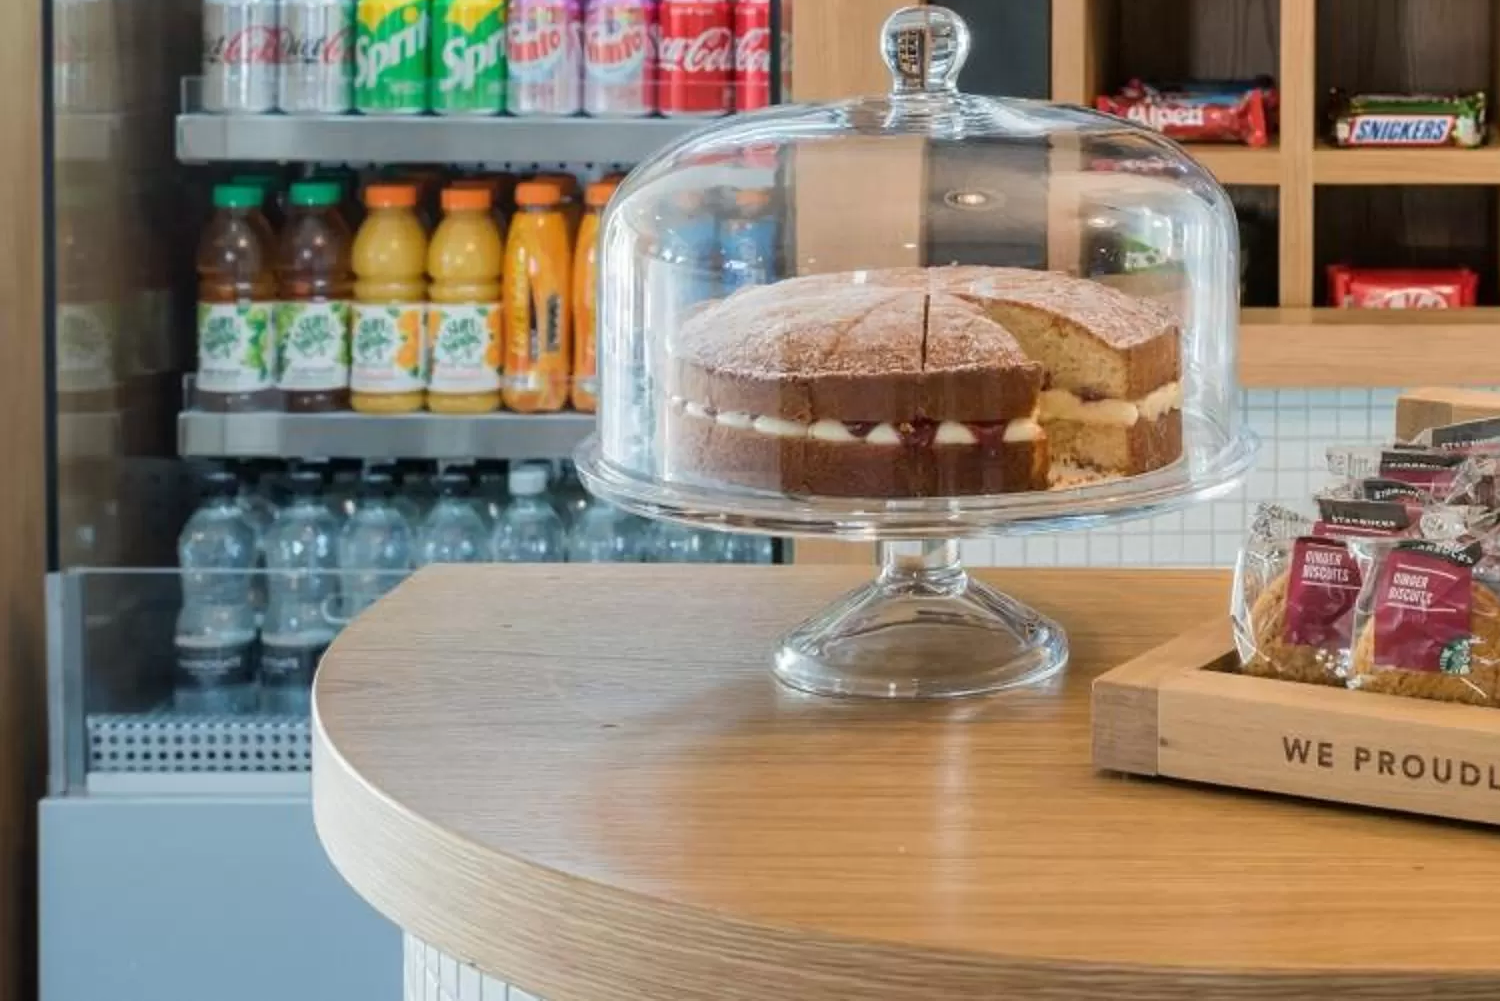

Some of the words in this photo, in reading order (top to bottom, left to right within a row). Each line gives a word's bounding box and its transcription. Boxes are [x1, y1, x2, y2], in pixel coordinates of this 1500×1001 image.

[1355, 117, 1448, 141] SNICKERS
[1331, 515, 1396, 528] STARBUCKS
[1305, 550, 1343, 566] GINGER
[1302, 564, 1349, 582] BISCUITS
[1393, 572, 1429, 589] GINGER
[1283, 736, 1334, 768] WE
